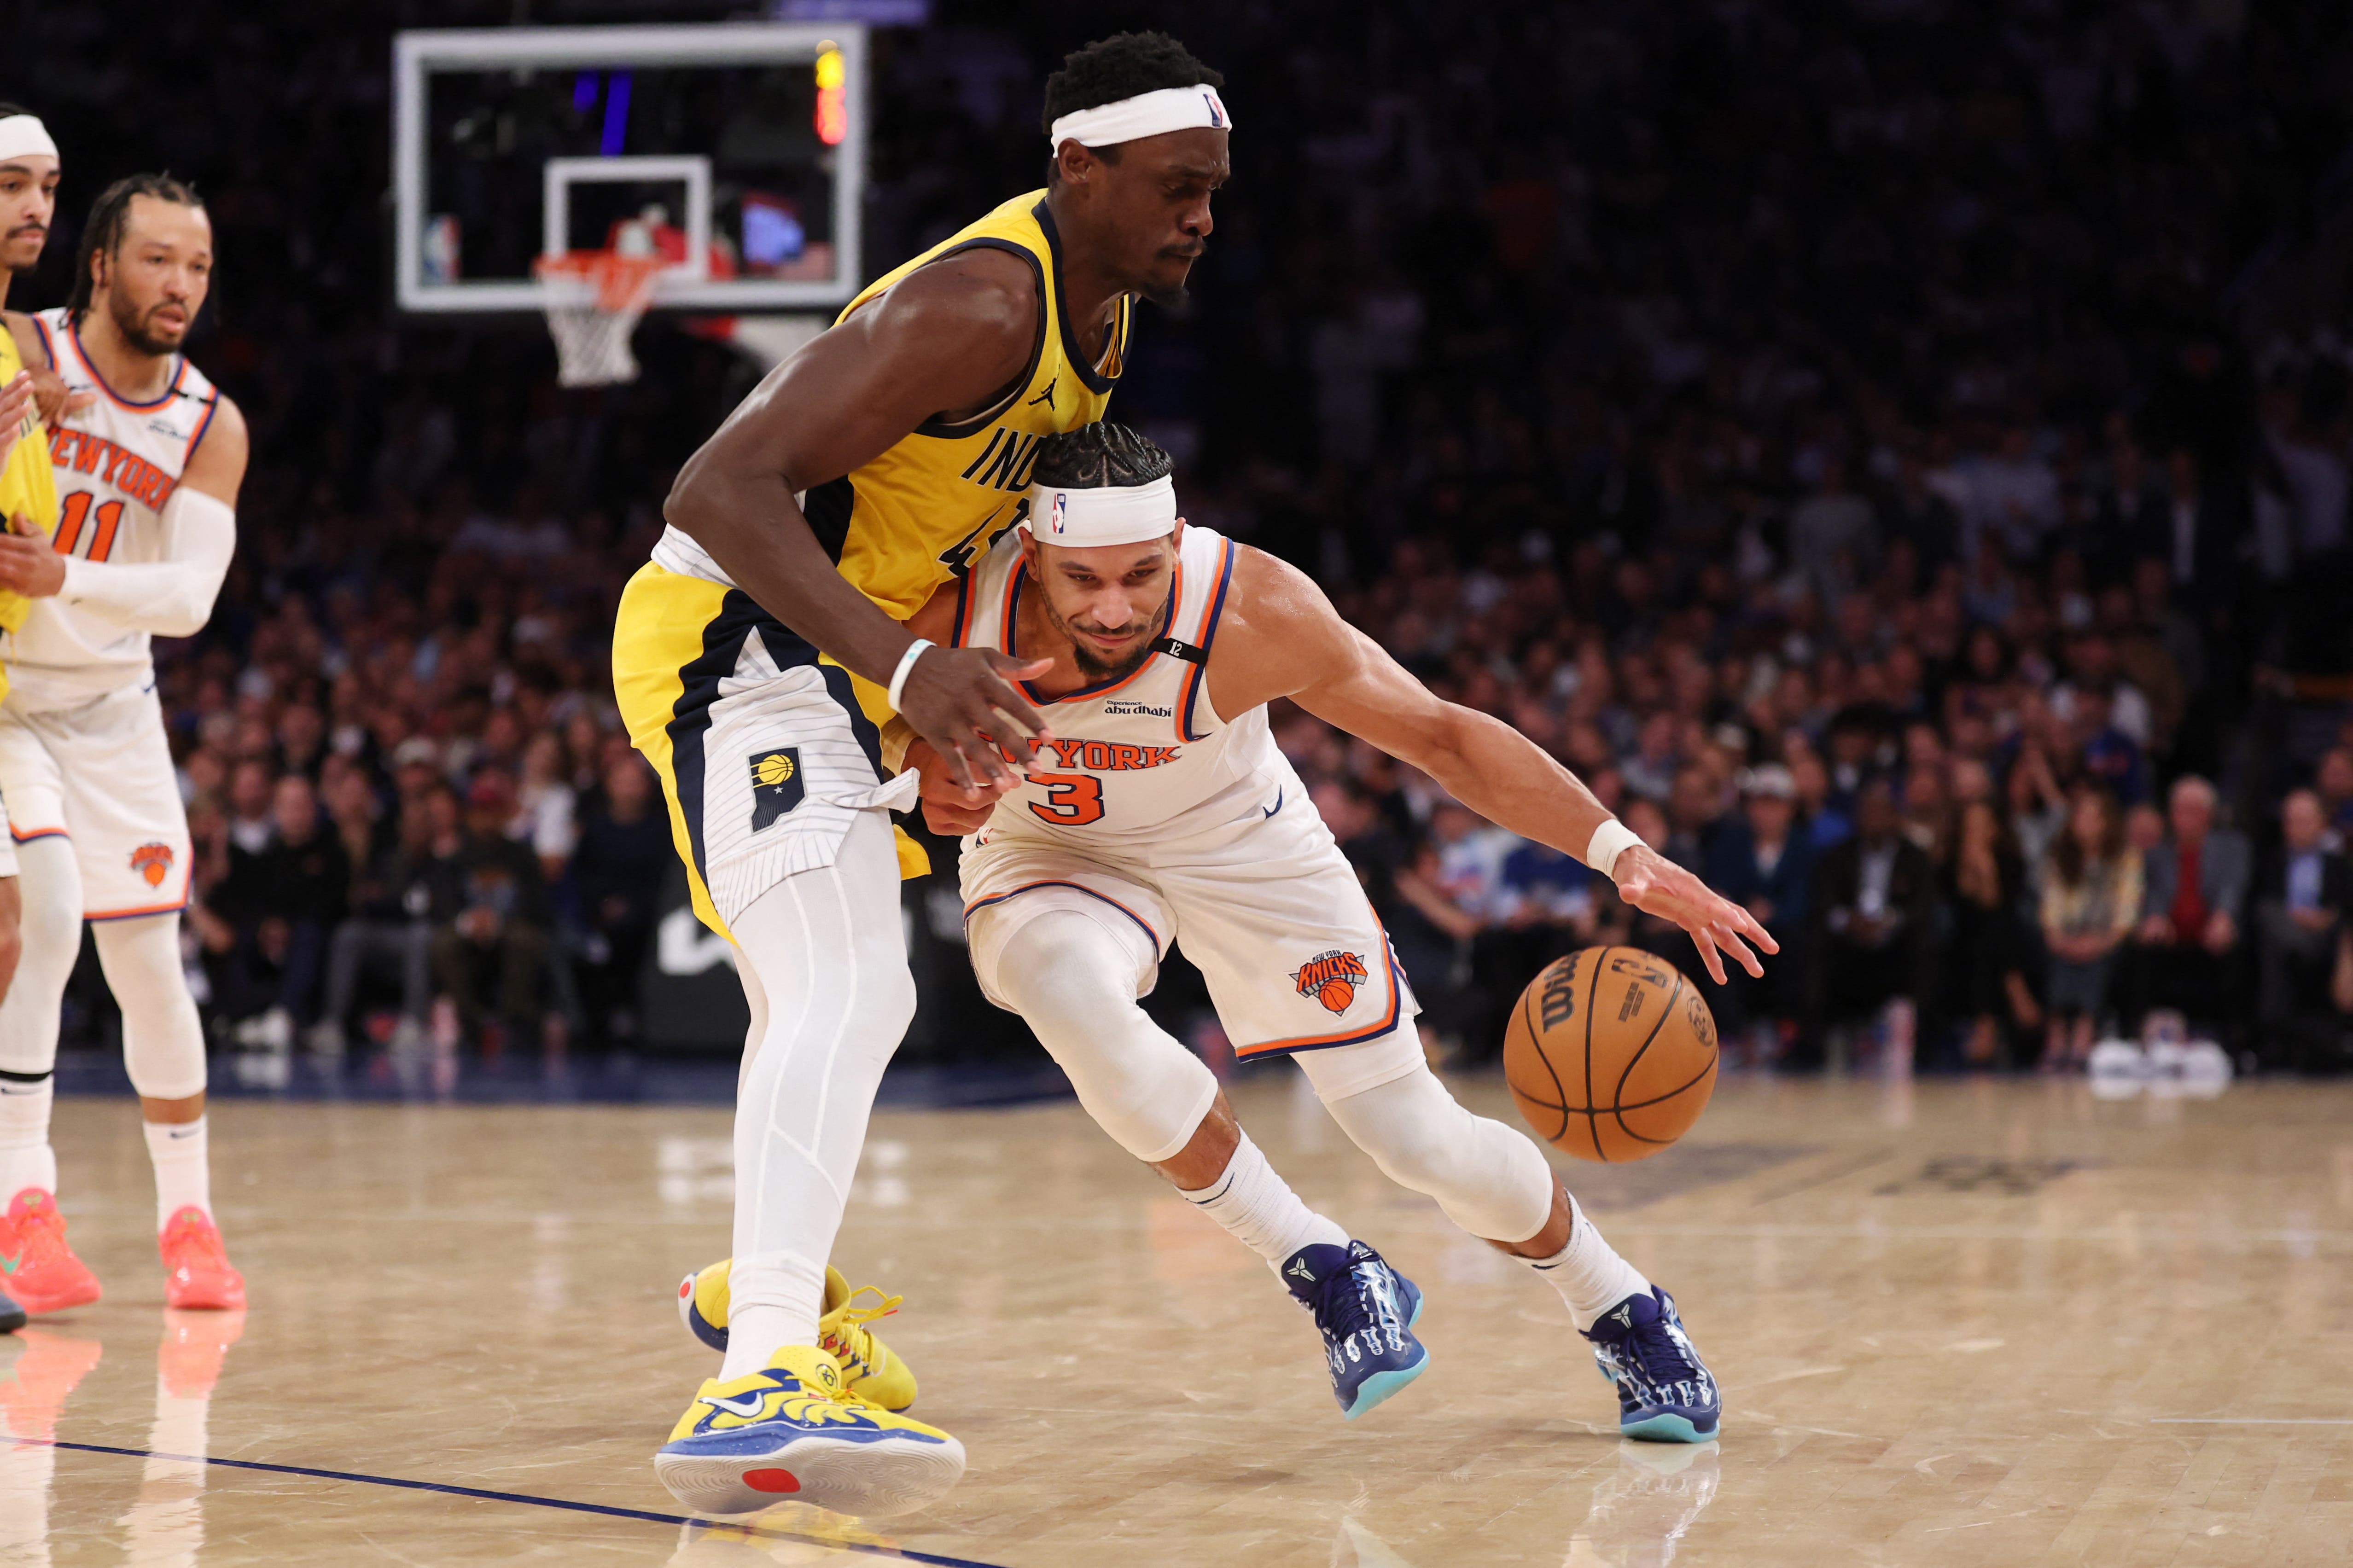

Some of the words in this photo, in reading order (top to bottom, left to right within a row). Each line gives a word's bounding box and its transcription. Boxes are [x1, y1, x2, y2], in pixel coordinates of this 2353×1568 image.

[52, 490, 125, 562] 11
[1169, 641, 1182, 657] 12
[1105, 706, 1130, 714] abu
[1048, 738, 1182, 771] YORK
[1025, 773, 1105, 825] 3
[1296, 952, 1368, 993] KNICKS
[1312, 952, 1325, 964] NEW
[1325, 950, 1342, 958] YORK
